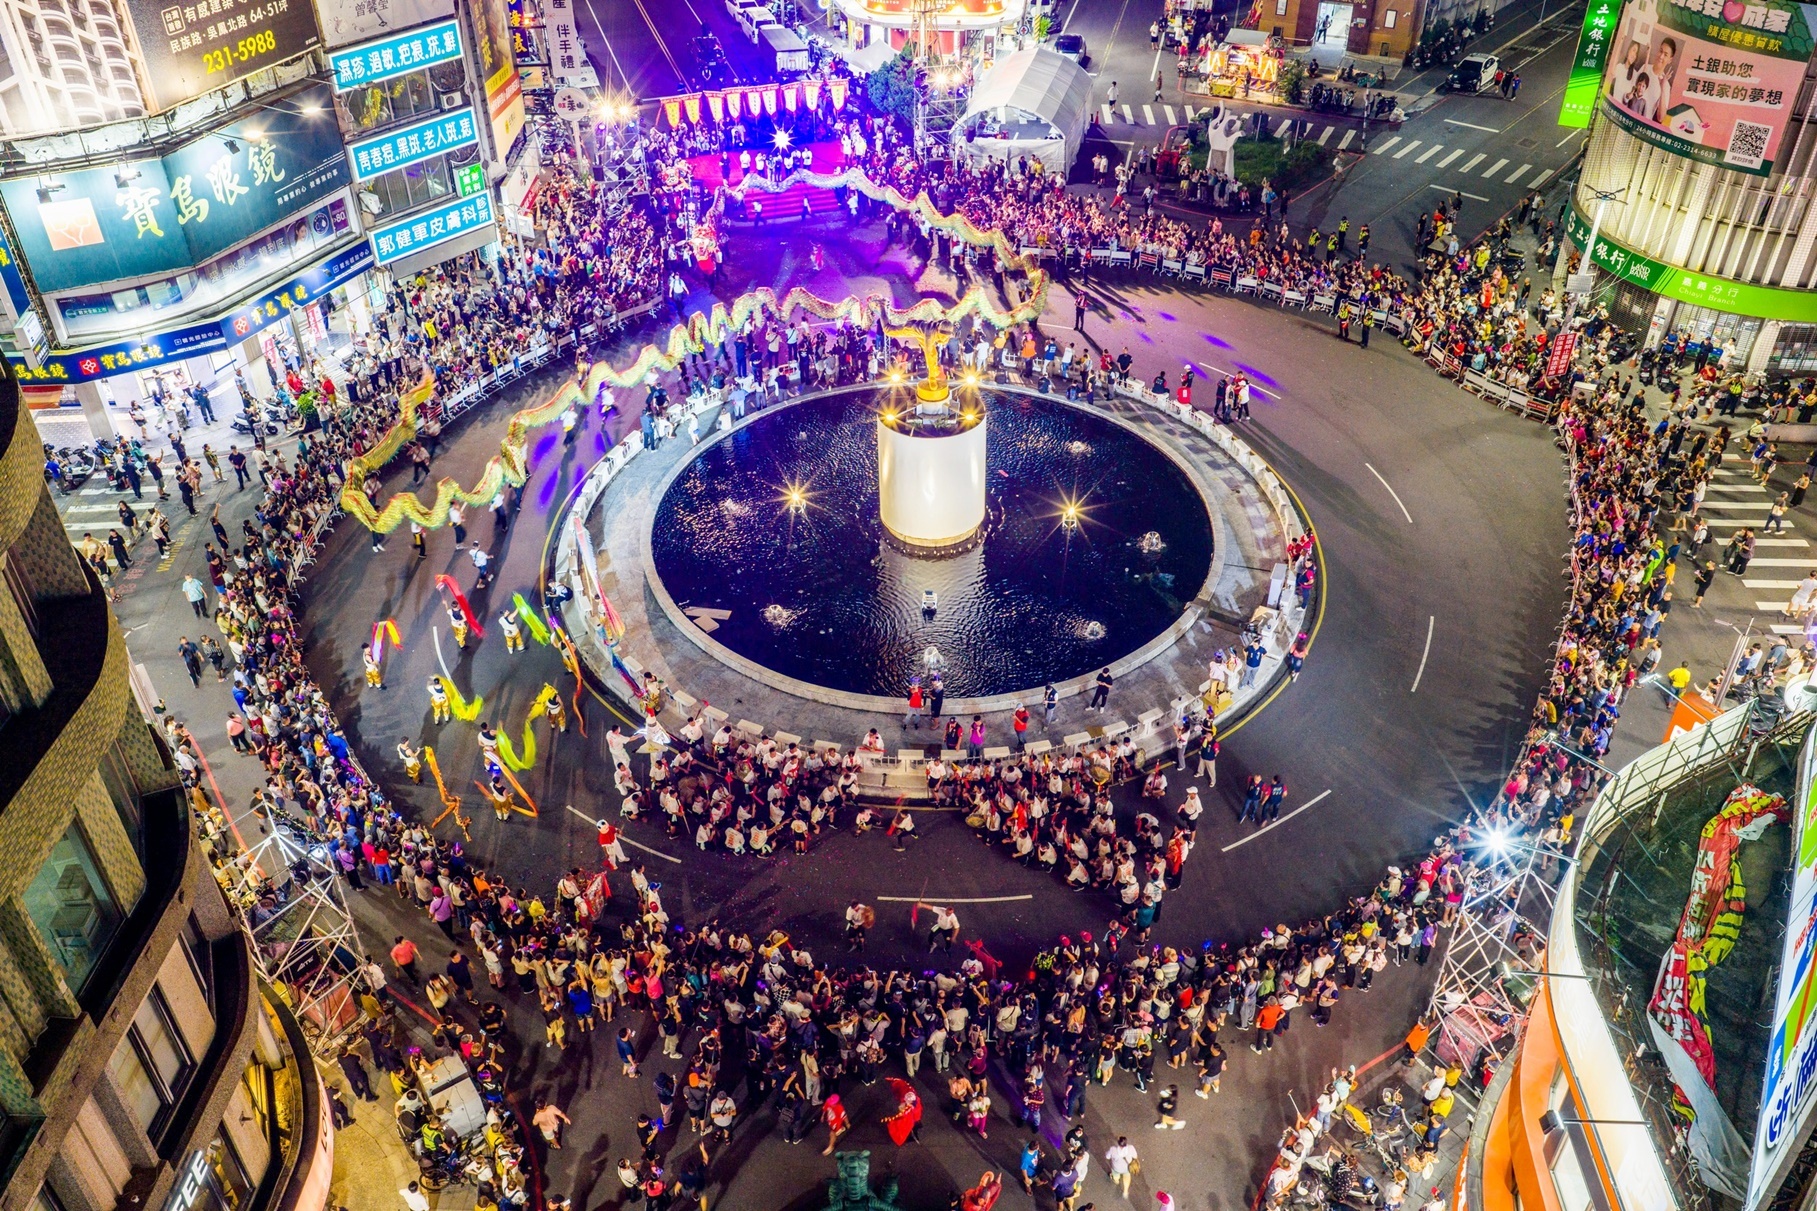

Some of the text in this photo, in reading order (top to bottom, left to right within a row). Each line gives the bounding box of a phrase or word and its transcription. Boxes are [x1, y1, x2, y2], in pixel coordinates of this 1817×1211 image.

[1586, 4, 1609, 57] 土地銀行
[1707, 25, 1782, 52] 購屋優惠貸款
[203, 30, 276, 75] 231-5988
[557, 24, 575, 68] 伴手禮
[1692, 55, 1754, 78] 土銀助您
[1687, 78, 1783, 105] 實現家的夢想
[114, 138, 285, 240] 寶島眼鏡
[1630, 266, 1648, 281] BANK
[1632, 261, 1650, 275] LAND
[1679, 287, 1736, 306] Chiayi Branch
[1682, 276, 1739, 297] 嘉義分行
[101, 345, 164, 370] 寶島眼鏡
